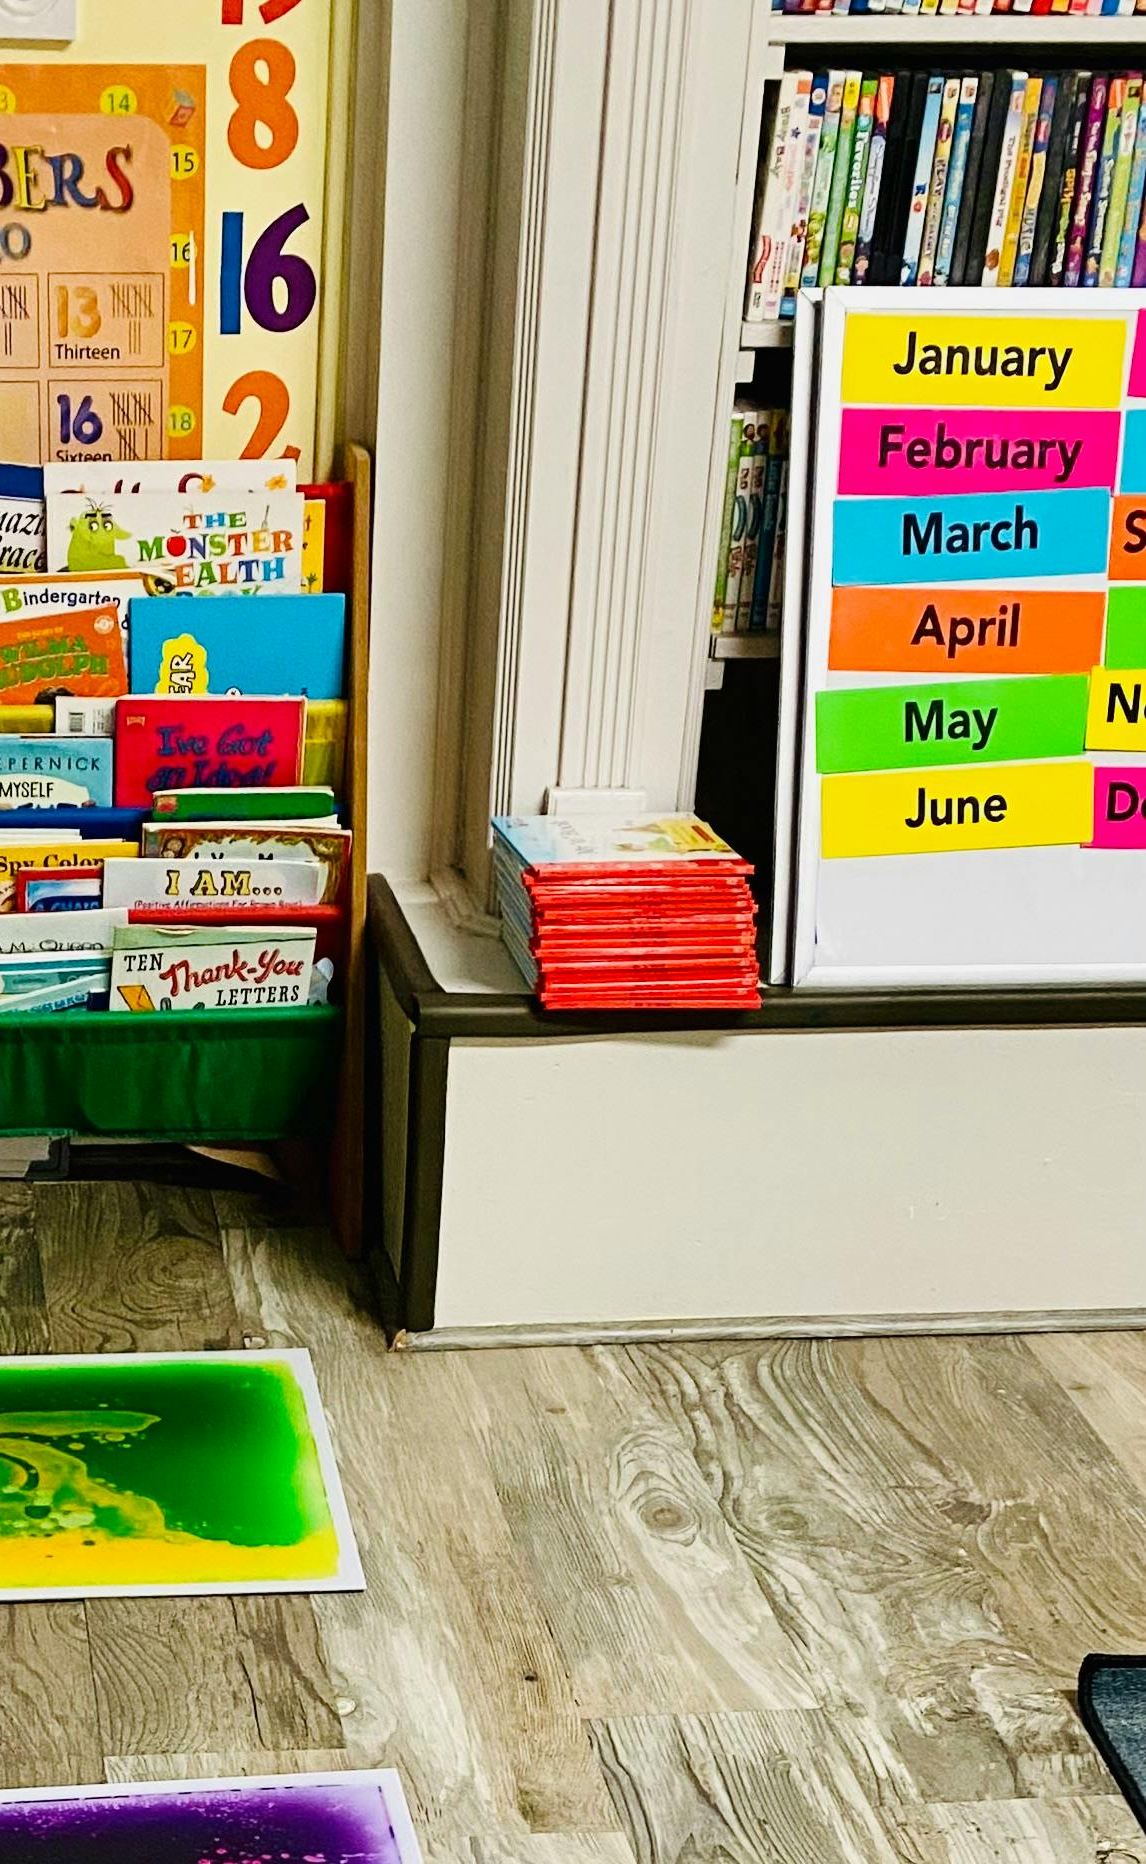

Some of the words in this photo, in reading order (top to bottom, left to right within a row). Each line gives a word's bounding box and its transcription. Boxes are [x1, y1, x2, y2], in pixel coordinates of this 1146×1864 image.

[108, 93, 130, 112] 14
[227, 37, 299, 169] 8
[172, 152, 195, 172] 15
[848, 131, 870, 209] Favorites
[172, 242, 191, 262] 16
[220, 203, 317, 335] 16
[56, 285, 102, 338] 13
[55, 344, 121, 360] Thirteen
[171, 329, 192, 349] 17
[893, 331, 1073, 391] January
[56, 394, 103, 445] 16
[169, 413, 192, 431] 18
[222, 370, 301, 460] 2
[56, 450, 113, 462] Sixteen
[878, 423, 1083, 483] February
[183, 511, 247, 530] THE
[902, 505, 1039, 556] March
[137, 529, 294, 562] MONSTER
[174, 556, 286, 588] EALTH
[1, 588, 121, 614] Bindergarten
[910, 604, 1021, 659] April
[156, 725, 208, 756] I've
[217, 724, 274, 756] Got
[904, 699, 998, 751] May
[0, 781, 55, 798] MYSELF
[905, 788, 1008, 829] June
[165, 870, 181, 896] I
[124, 953, 164, 972] TEN
[159, 948, 305, 997] Thank-You
[215, 985, 300, 1006] LETTERS
